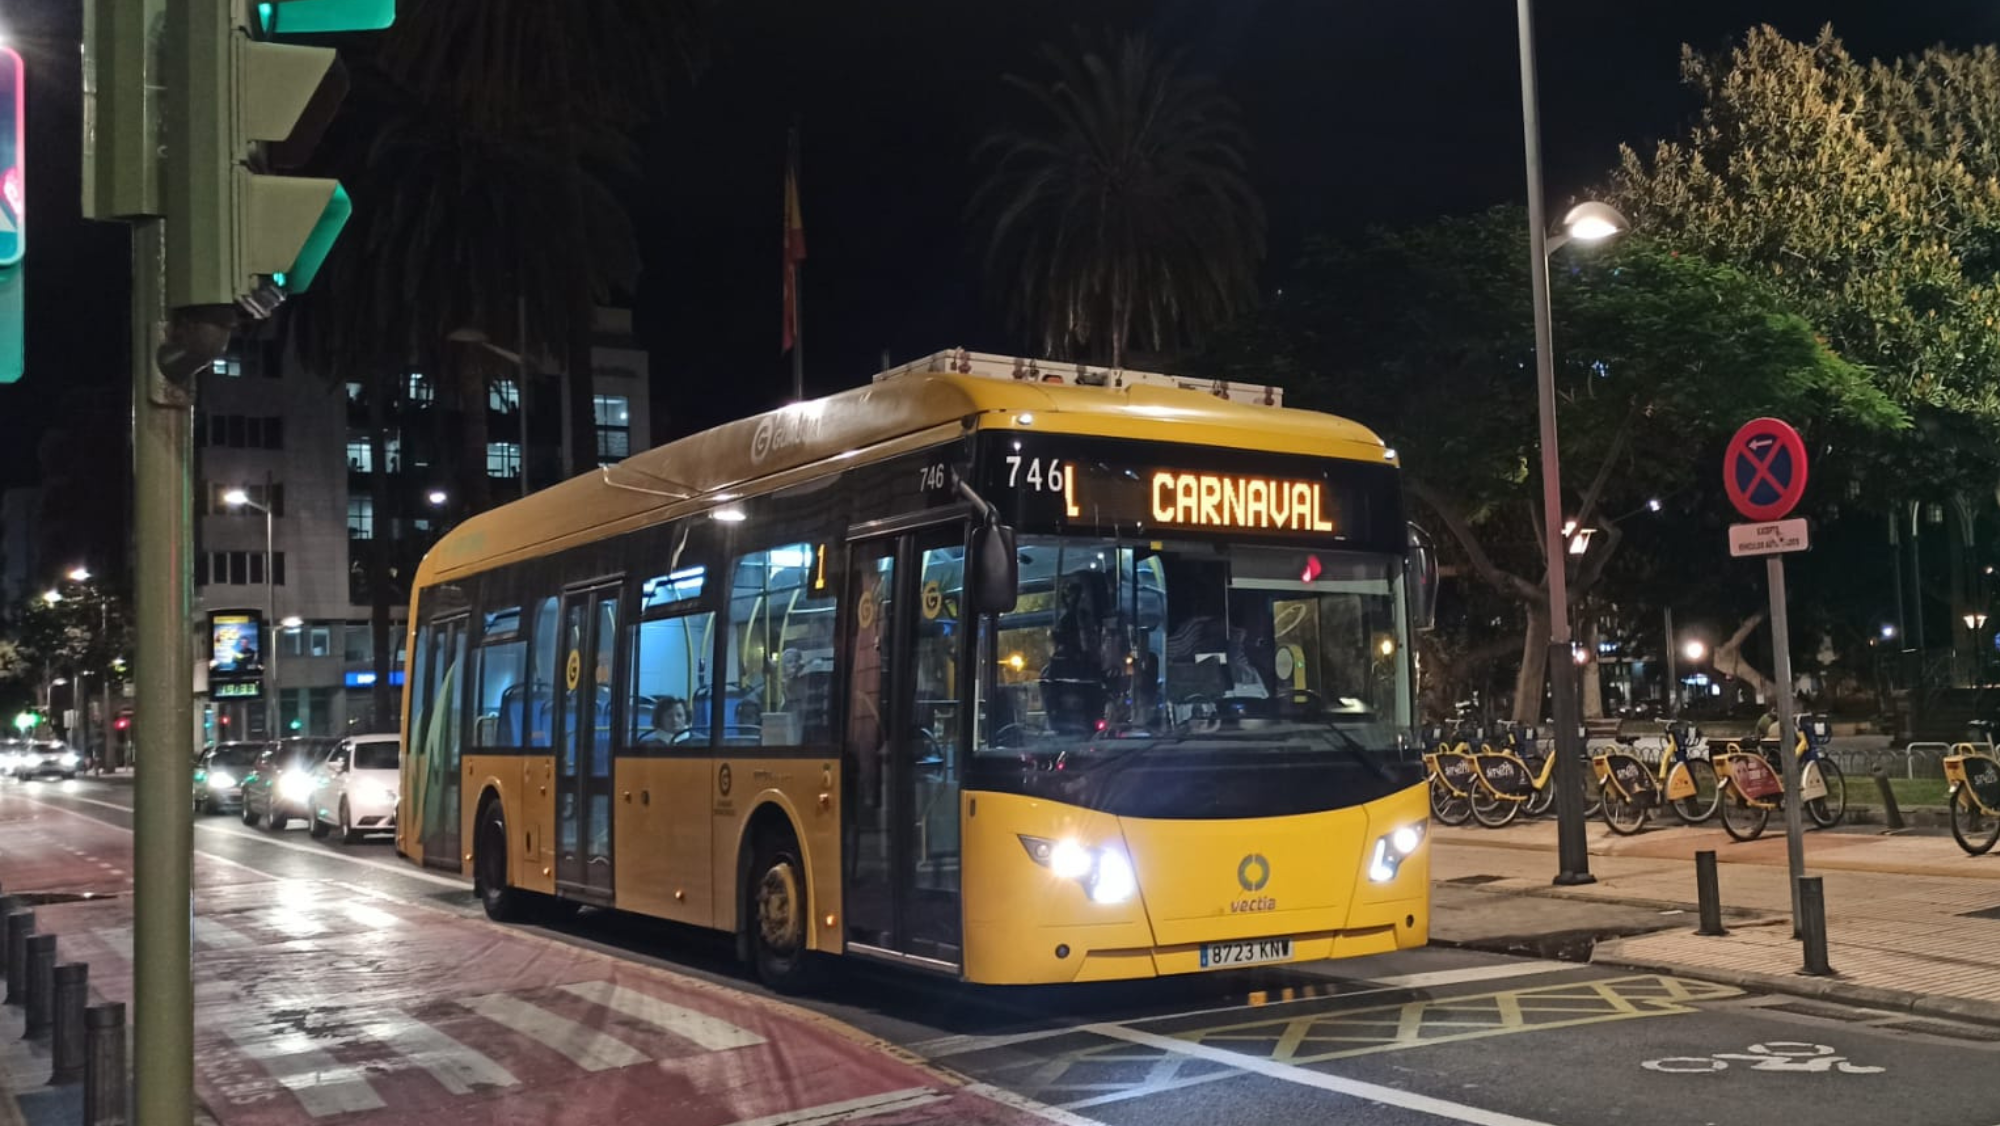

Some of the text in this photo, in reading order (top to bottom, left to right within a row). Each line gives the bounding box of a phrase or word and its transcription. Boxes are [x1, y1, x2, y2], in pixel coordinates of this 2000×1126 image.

[920, 463, 945, 492] 746
[1006, 456, 1063, 492] 746
[1152, 472, 1333, 532] CARNAVAL
[1230, 896, 1277, 913] vectia
[1211, 938, 1291, 964] 8723 KNW
